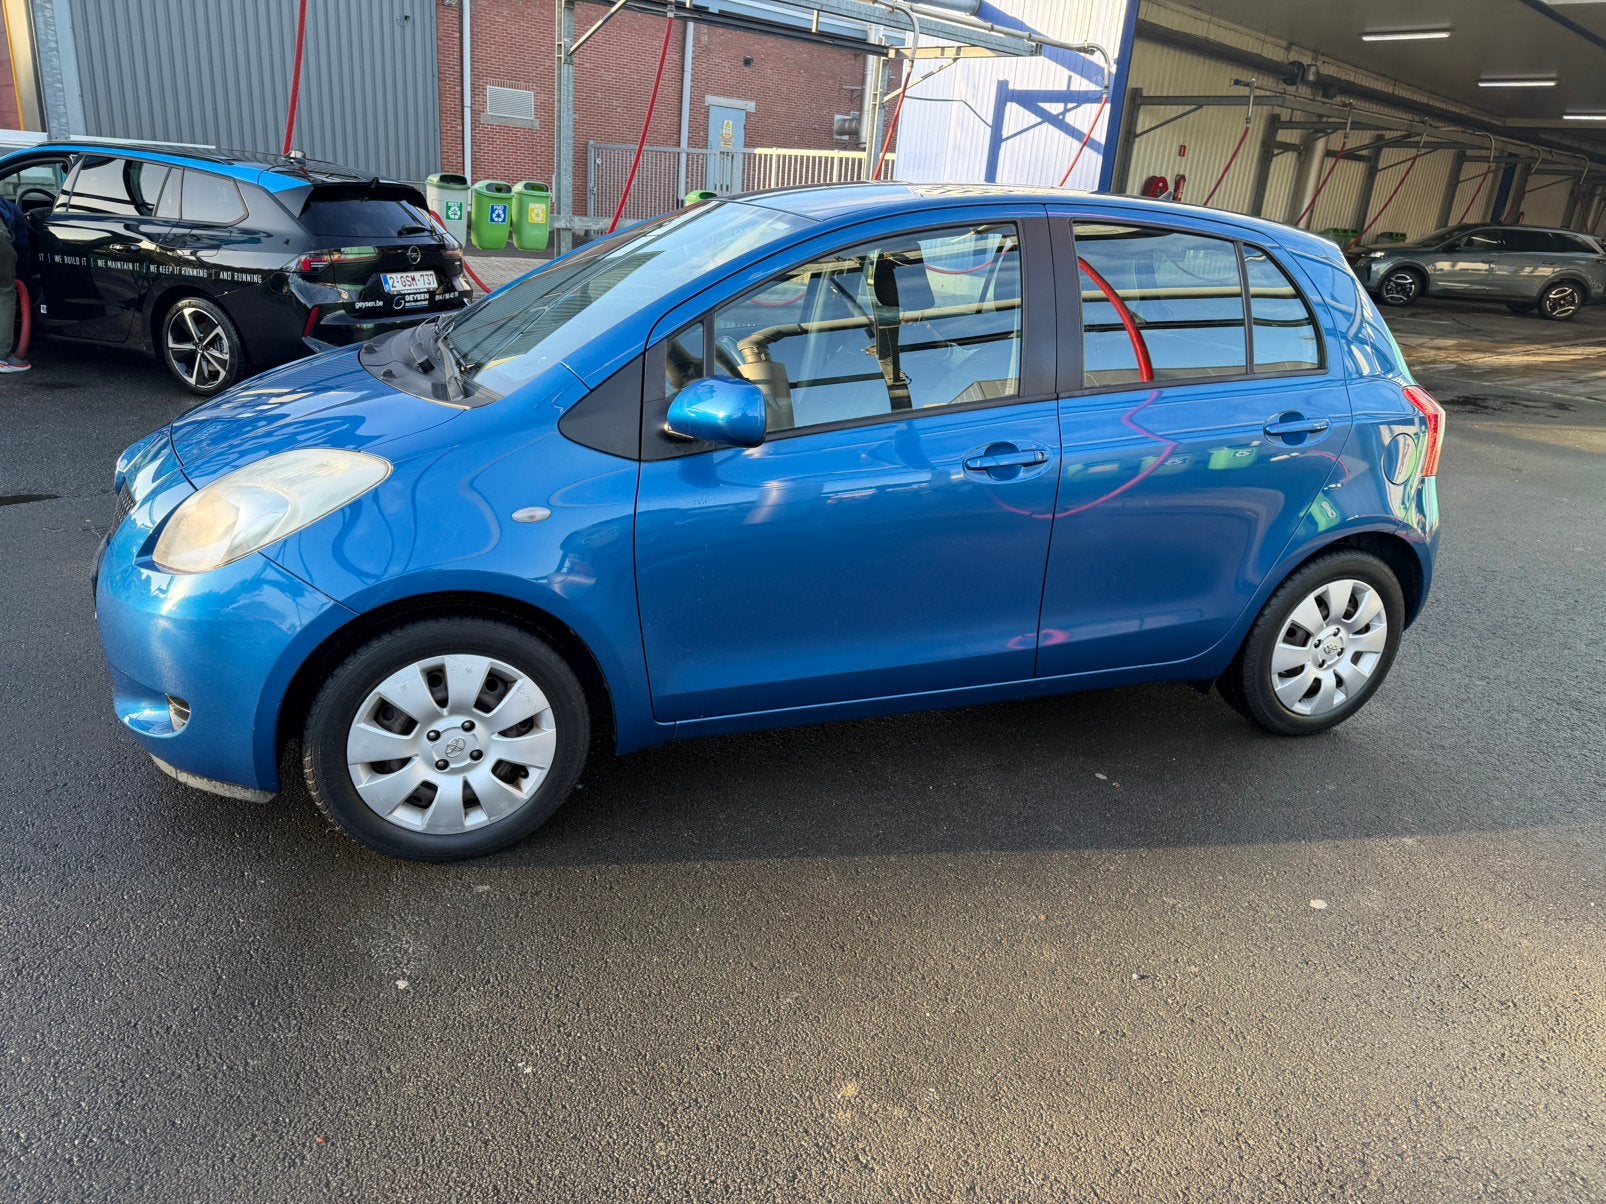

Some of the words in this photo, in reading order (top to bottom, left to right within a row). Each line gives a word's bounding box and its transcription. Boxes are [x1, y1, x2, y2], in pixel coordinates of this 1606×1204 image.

[54, 255, 62, 263] WE
[64, 256, 79, 265] BUILD
[81, 257, 87, 266] IT
[97, 260, 105, 268] WE
[107, 260, 133, 270] MAINTAIN
[134, 262, 140, 271] IT
[150, 264, 157, 273] WE
[160, 265, 173, 275] KEEP
[174, 266, 180, 275] IT
[181, 266, 207, 277] RUNNING
[220, 271, 232, 280] AND
[234, 272, 262, 283] RUNNING
[405, 293, 429, 301] GEYSEN
[355, 300, 383, 309] geysen.be
